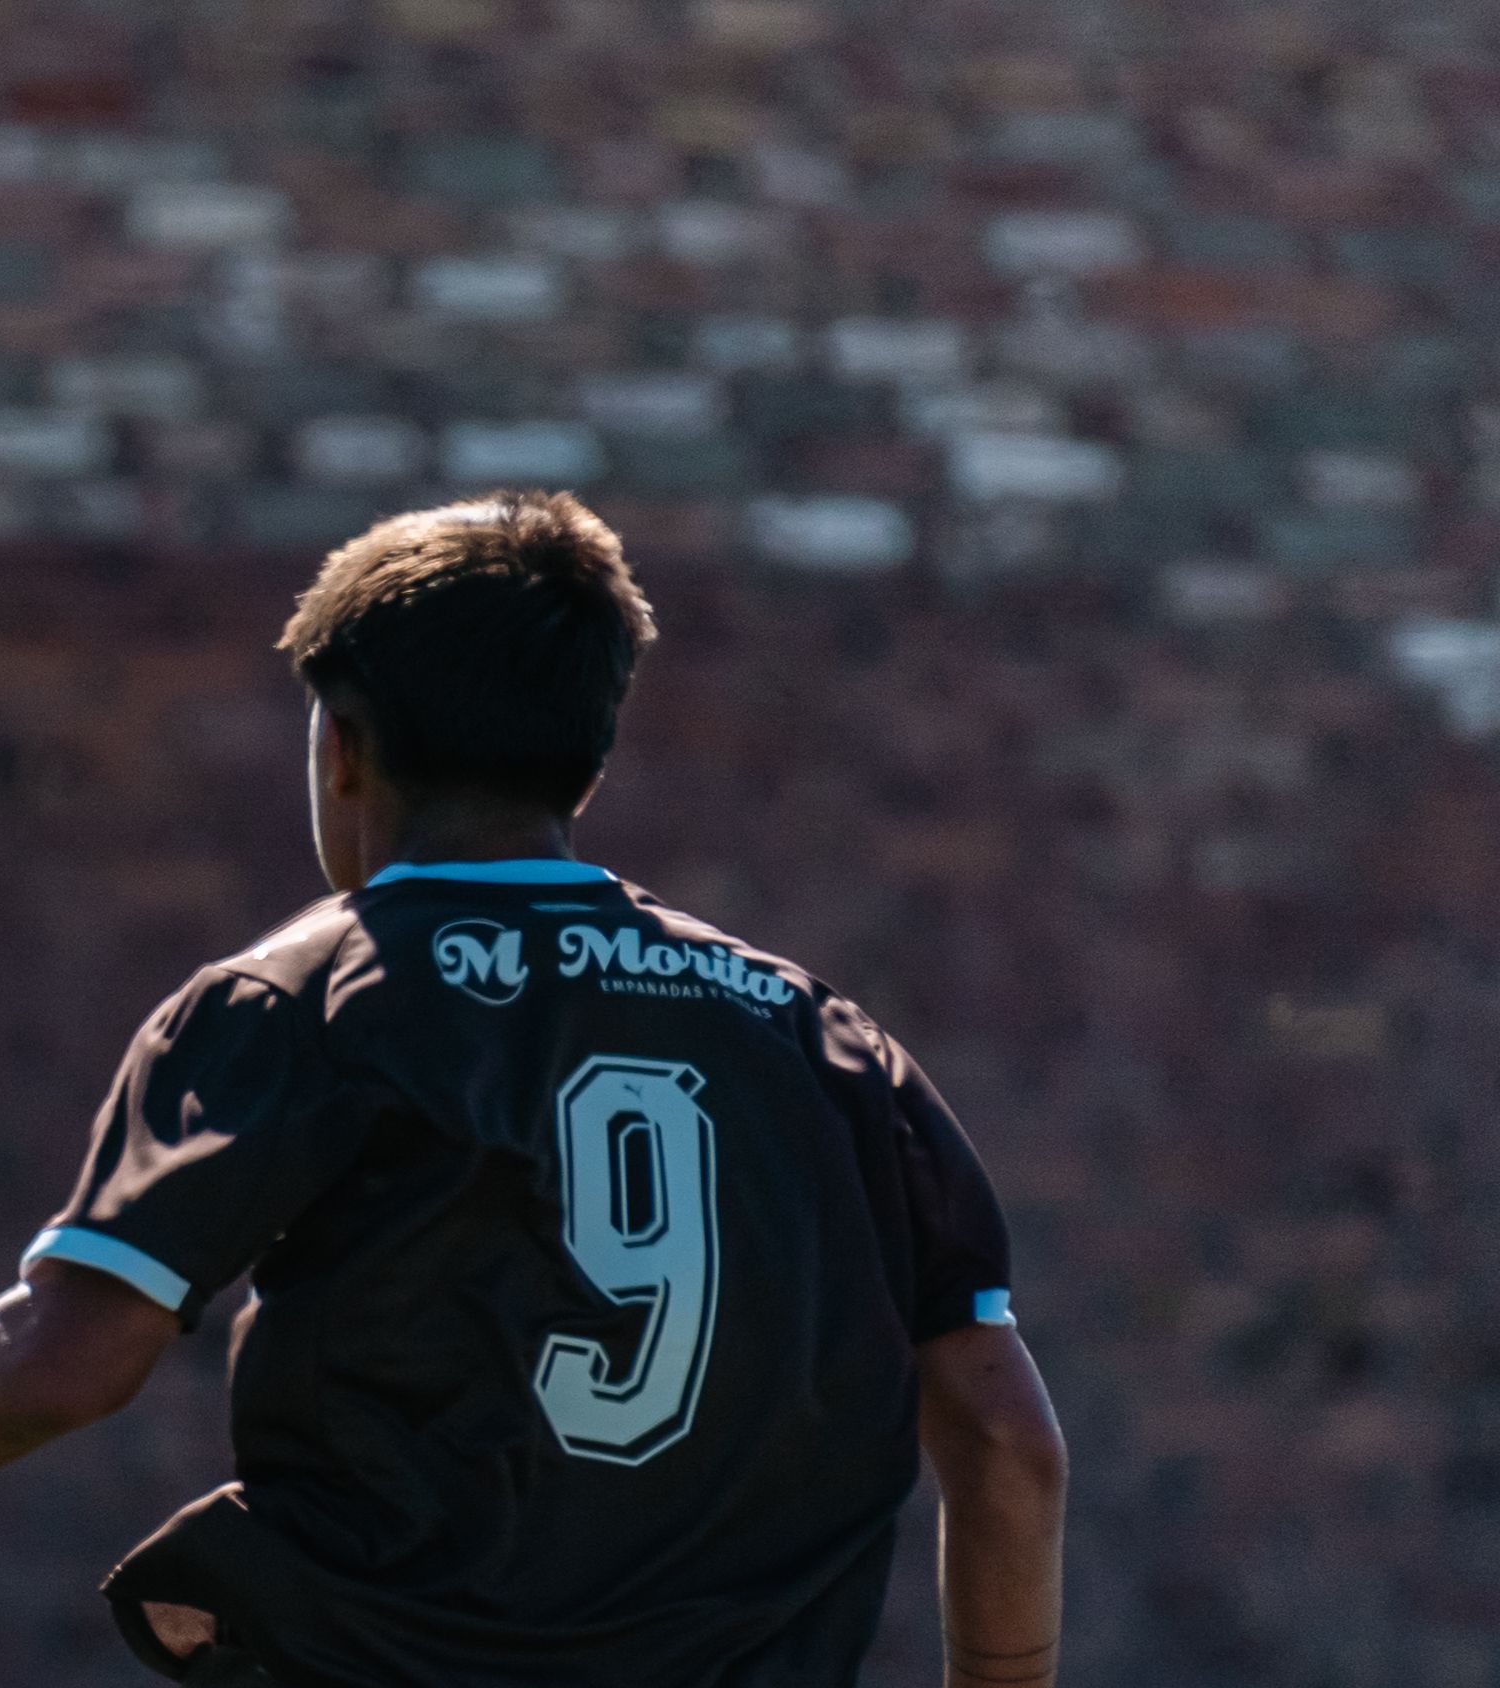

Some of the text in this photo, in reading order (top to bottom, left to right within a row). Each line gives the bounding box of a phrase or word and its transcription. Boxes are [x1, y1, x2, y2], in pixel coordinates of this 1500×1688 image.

[438, 929, 530, 988] M
[557, 923, 795, 1006] Morita
[599, 978, 704, 999] EMPANADAS
[532, 1053, 720, 1468] 9
